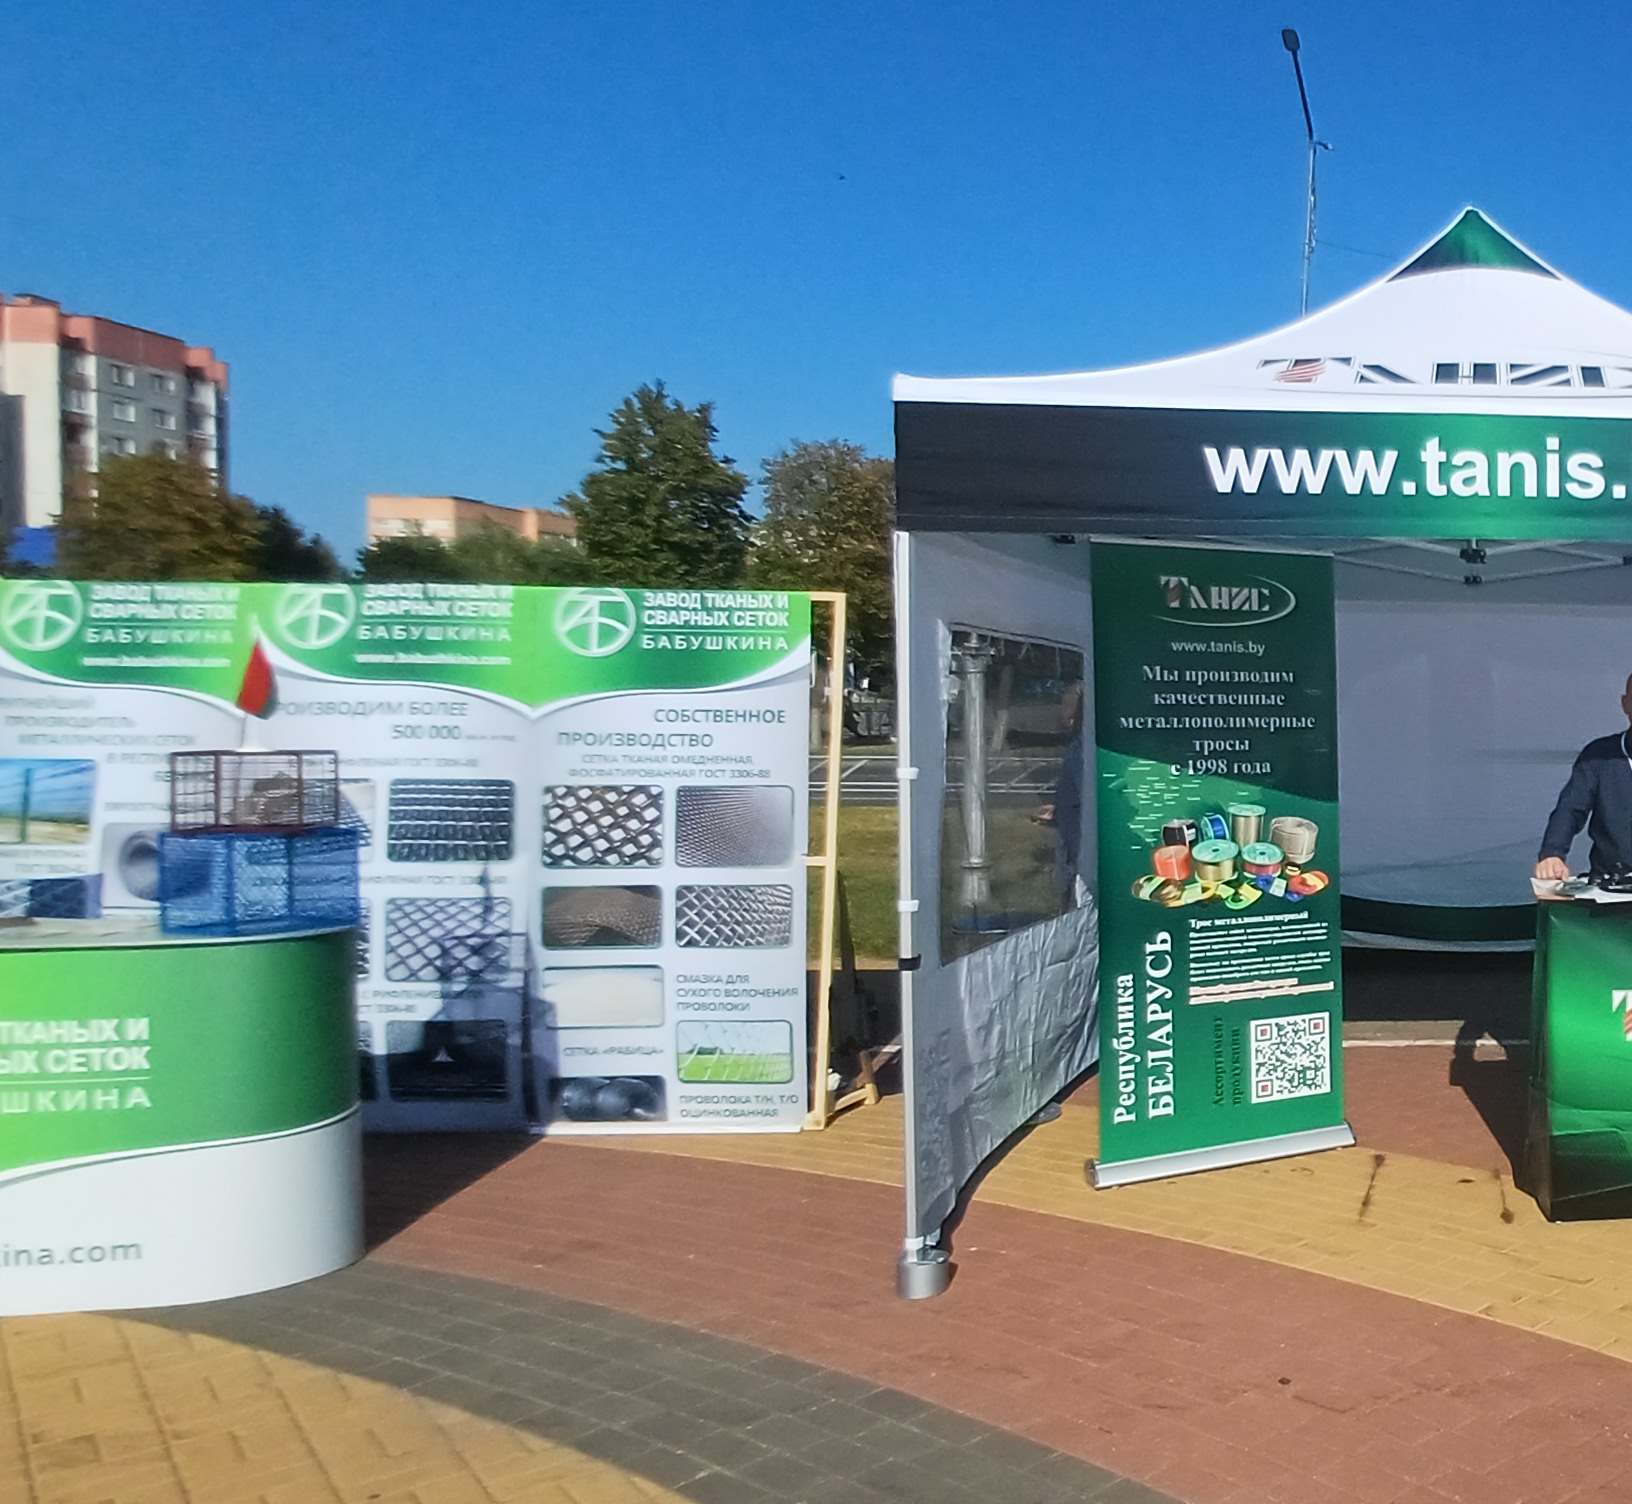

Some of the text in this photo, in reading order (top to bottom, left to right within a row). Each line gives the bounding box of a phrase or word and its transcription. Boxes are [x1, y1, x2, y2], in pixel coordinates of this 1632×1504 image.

[642, 591, 790, 610] ЗАВОД ТКАНЫХ И
[643, 610, 790, 628] СВАРНЫХ СЕТОК
[86, 628, 234, 644] БАБУШКИНА
[357, 624, 513, 642] БАБУШКИНА
[641, 634, 789, 651] БАБУШКИНА
[1171, 640, 1266, 657] www.tanis.by
[1142, 665, 1295, 686] Мы производим
[1153, 689, 1286, 706] качественные
[276, 701, 469, 717] РОИЗВОДИМ БОЛЕЕ
[653, 708, 786, 724] СОБСТВЕННОЕ
[391, 724, 423, 740] 500
[428, 725, 461, 740] 000
[1119, 715, 1316, 732] металлополимерные
[556, 731, 715, 750] ПРОИЗВОДСТВО
[1192, 738, 1250, 755] тросы
[1170, 758, 1272, 776] с 1998 года
[676, 973, 750, 986] СМАЗКА ДЛЯ
[676, 987, 800, 999] СУХОГО ВОЛОЧЕНИЯ
[676, 1001, 752, 1013] ПРОВОЛОКИ
[0, 1017, 150, 1045] ТКАНЫХ И
[1145, 930, 1175, 1120] БЕЛАРУСЬ
[1112, 973, 1141, 1125] Республика
[44, 1046, 152, 1074] СЕТОК
[1, 1086, 152, 1114] ШКИНА
[679, 1094, 752, 1106] ПРОВОЛОКА
[2, 1242, 142, 1267] ina.com
